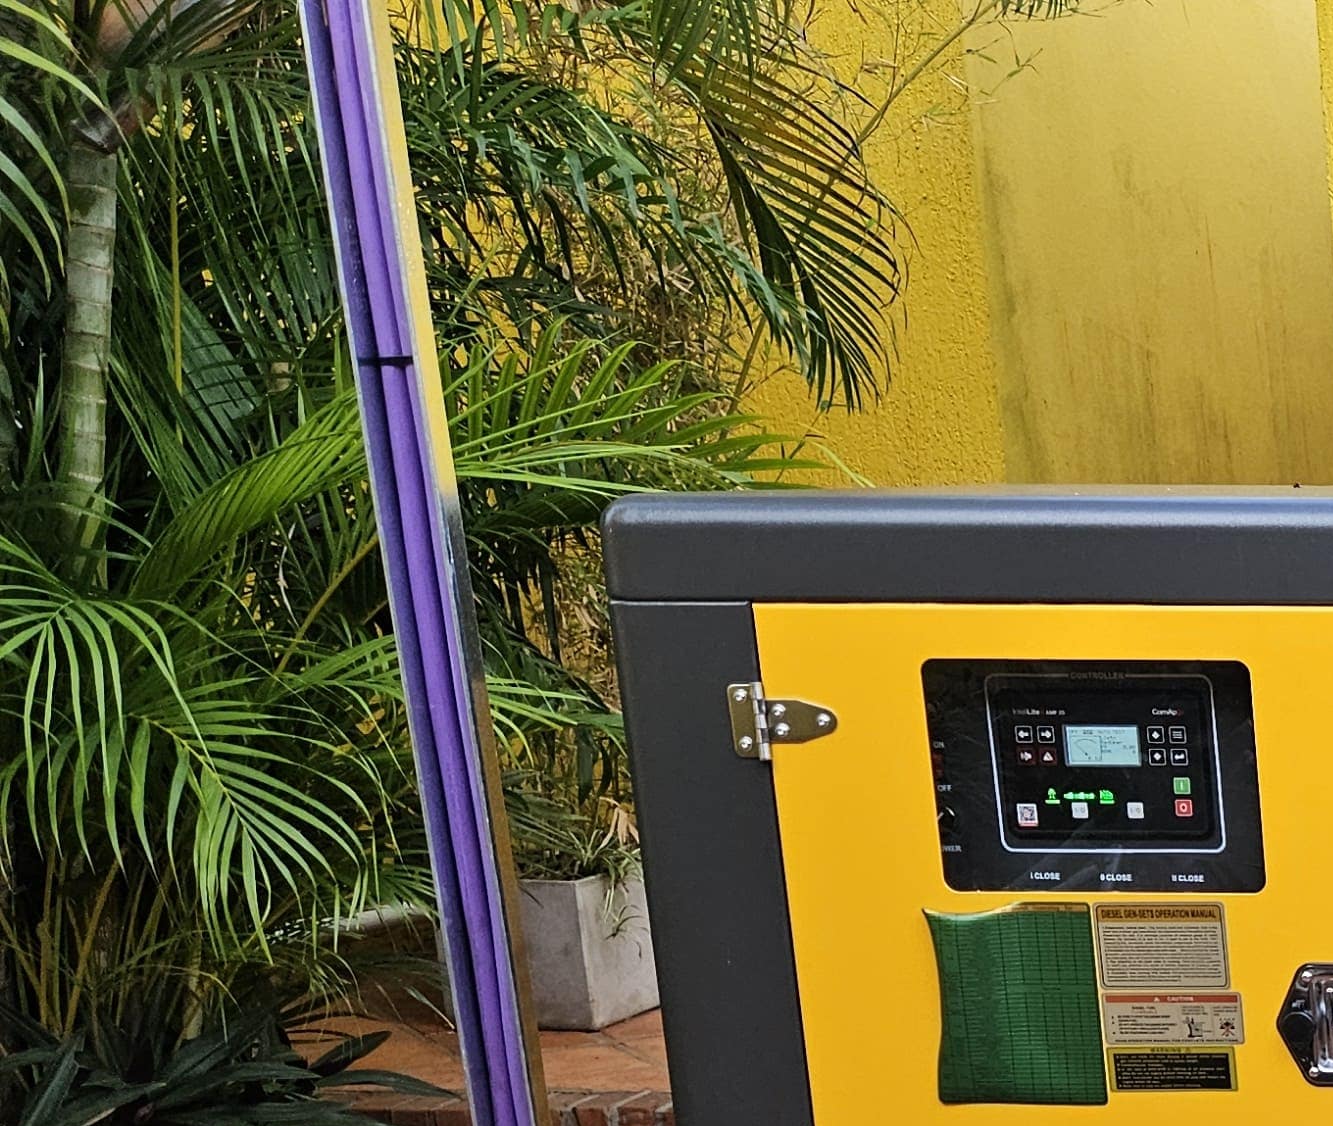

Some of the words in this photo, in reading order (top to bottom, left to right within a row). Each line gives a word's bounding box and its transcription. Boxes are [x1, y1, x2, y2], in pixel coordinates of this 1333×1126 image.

[1034, 872, 1060, 880] CLOSE
[1106, 873, 1133, 882] CLOSE
[1178, 874, 1205, 882] CLOSE
[1101, 909, 1123, 919] DIESEL
[1155, 909, 1190, 919] OPERATION
[1190, 909, 1217, 919] MANUAL
